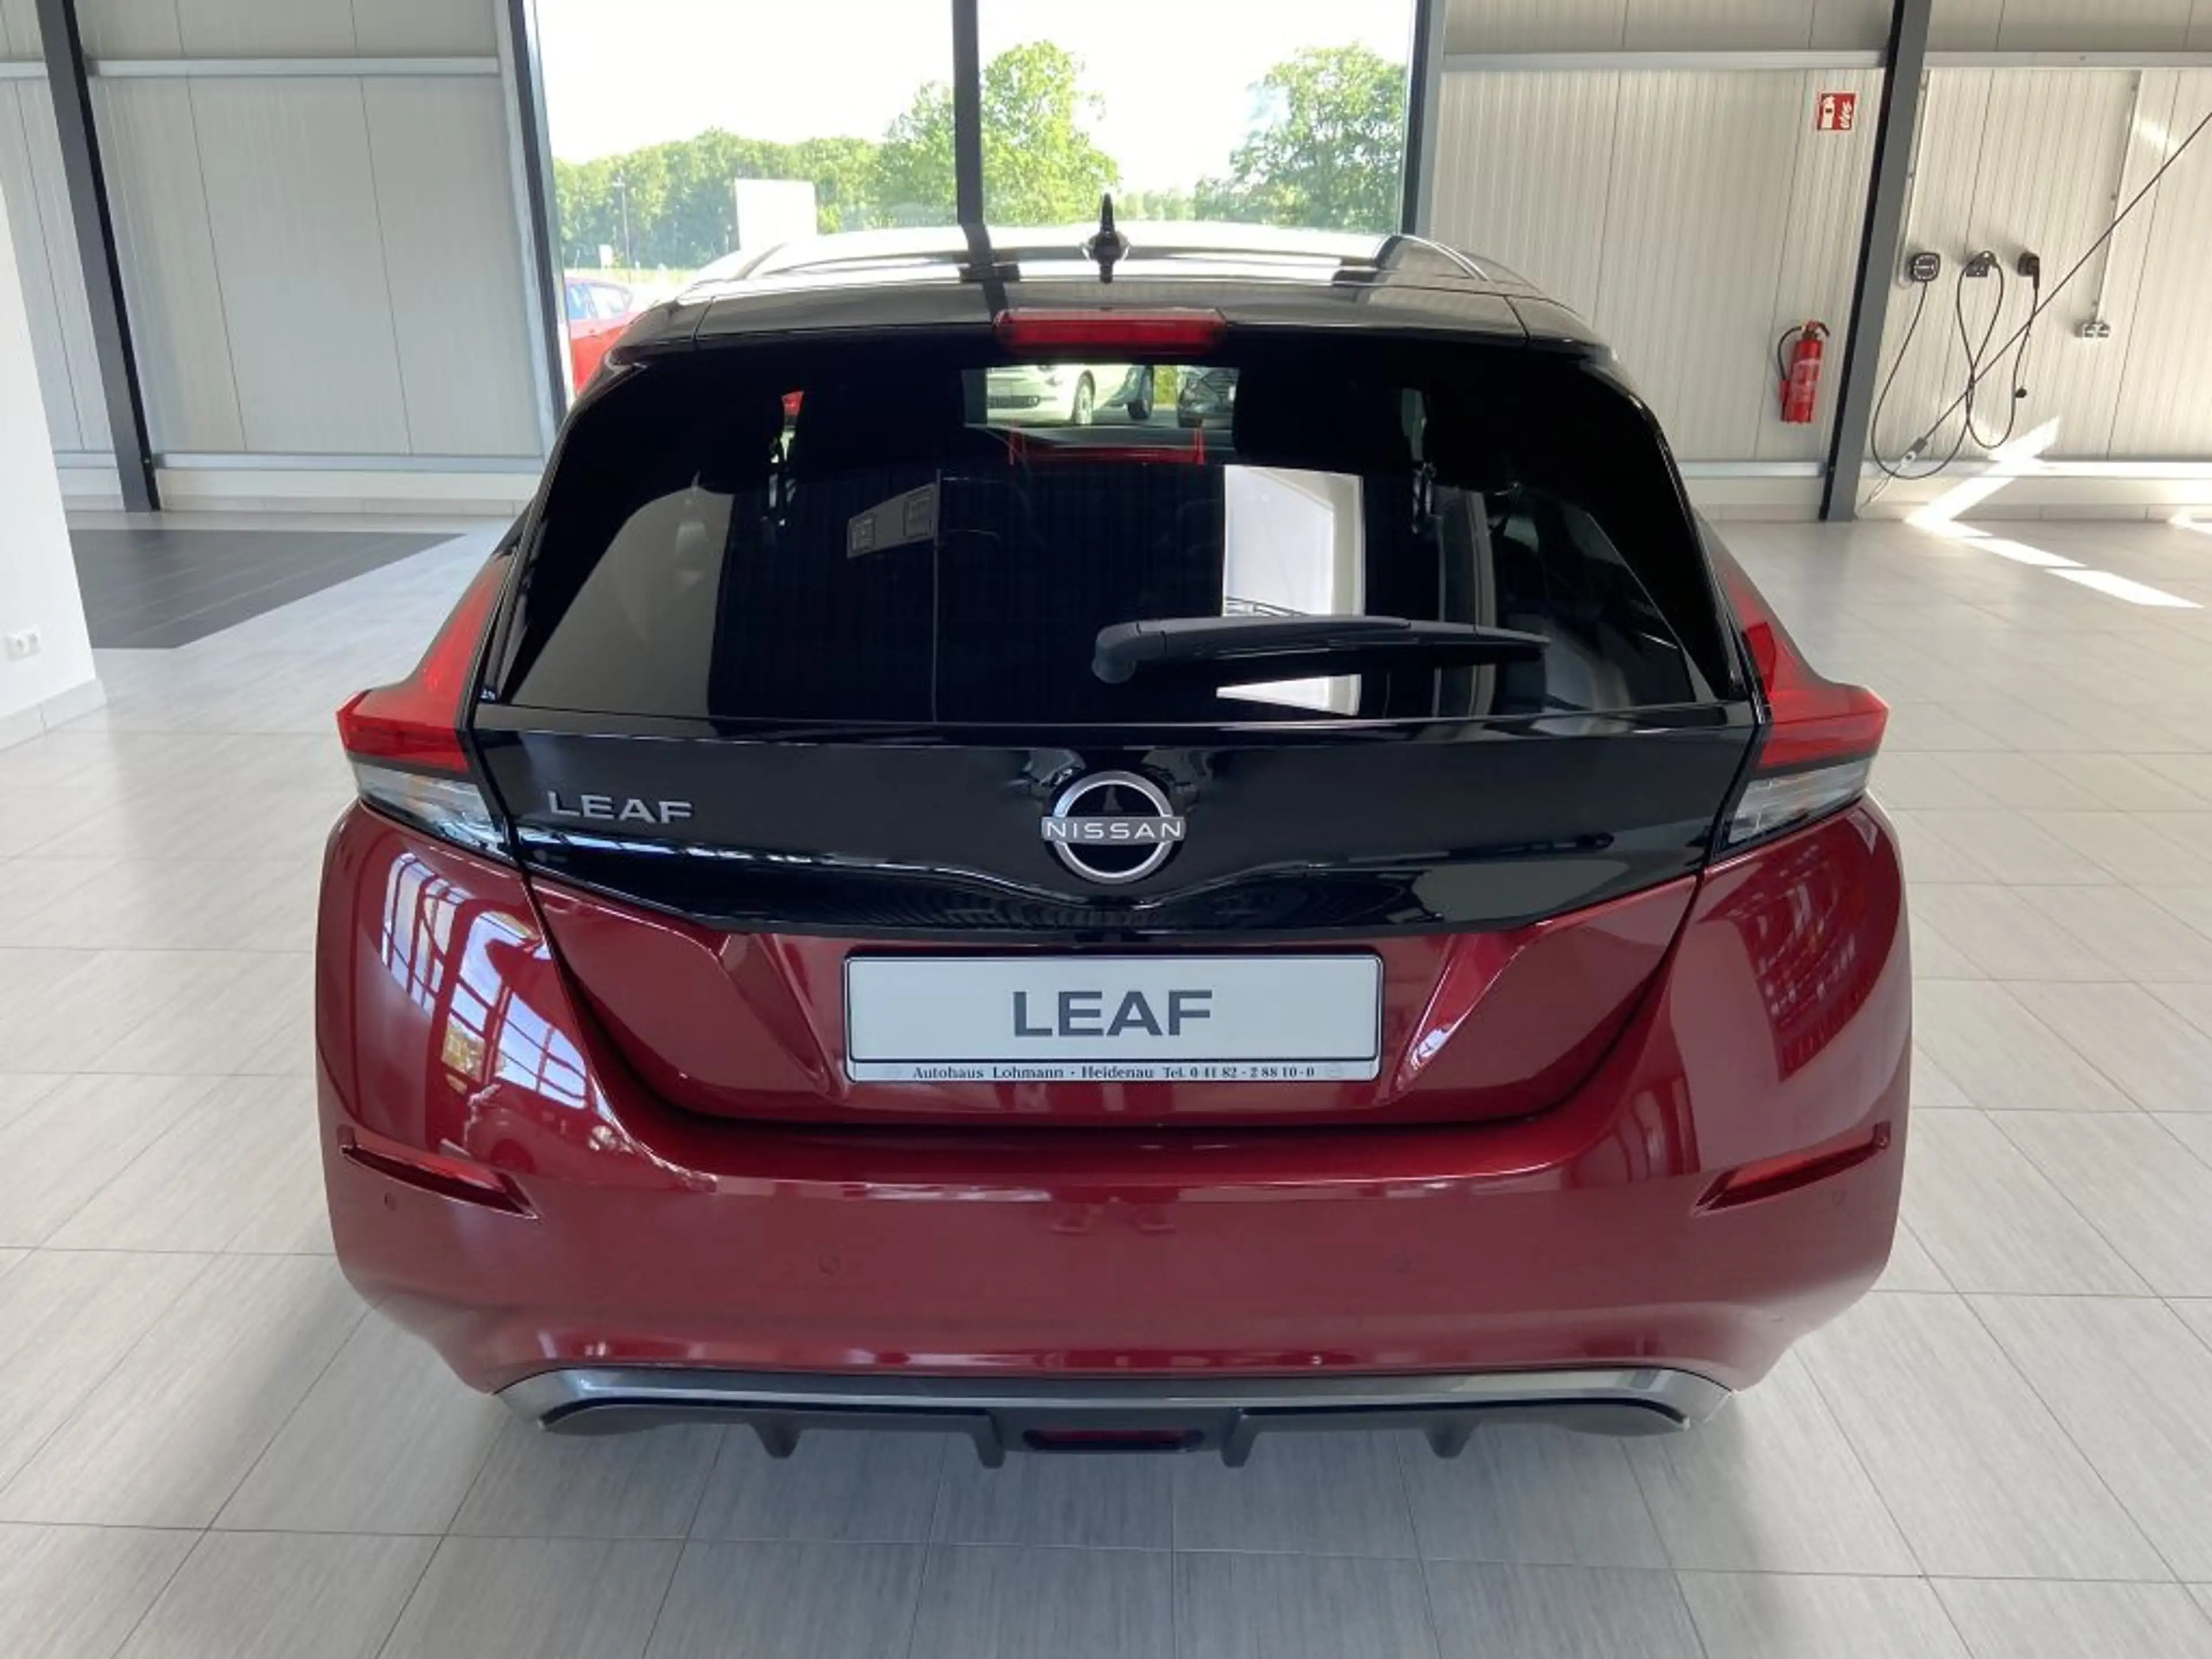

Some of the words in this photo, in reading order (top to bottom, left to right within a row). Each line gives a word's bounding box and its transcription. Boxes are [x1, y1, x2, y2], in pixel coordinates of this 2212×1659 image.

[547, 790, 692, 824] LEAF
[1046, 820, 1181, 839] NISSAN
[1013, 990, 1213, 1037] LEAF
[913, 1066, 984, 1079] Autohaus
[993, 1066, 1064, 1079] Lohmann
[1081, 1066, 1154, 1079] Heidenau
[1222, 1067, 1237, 1078] 82
